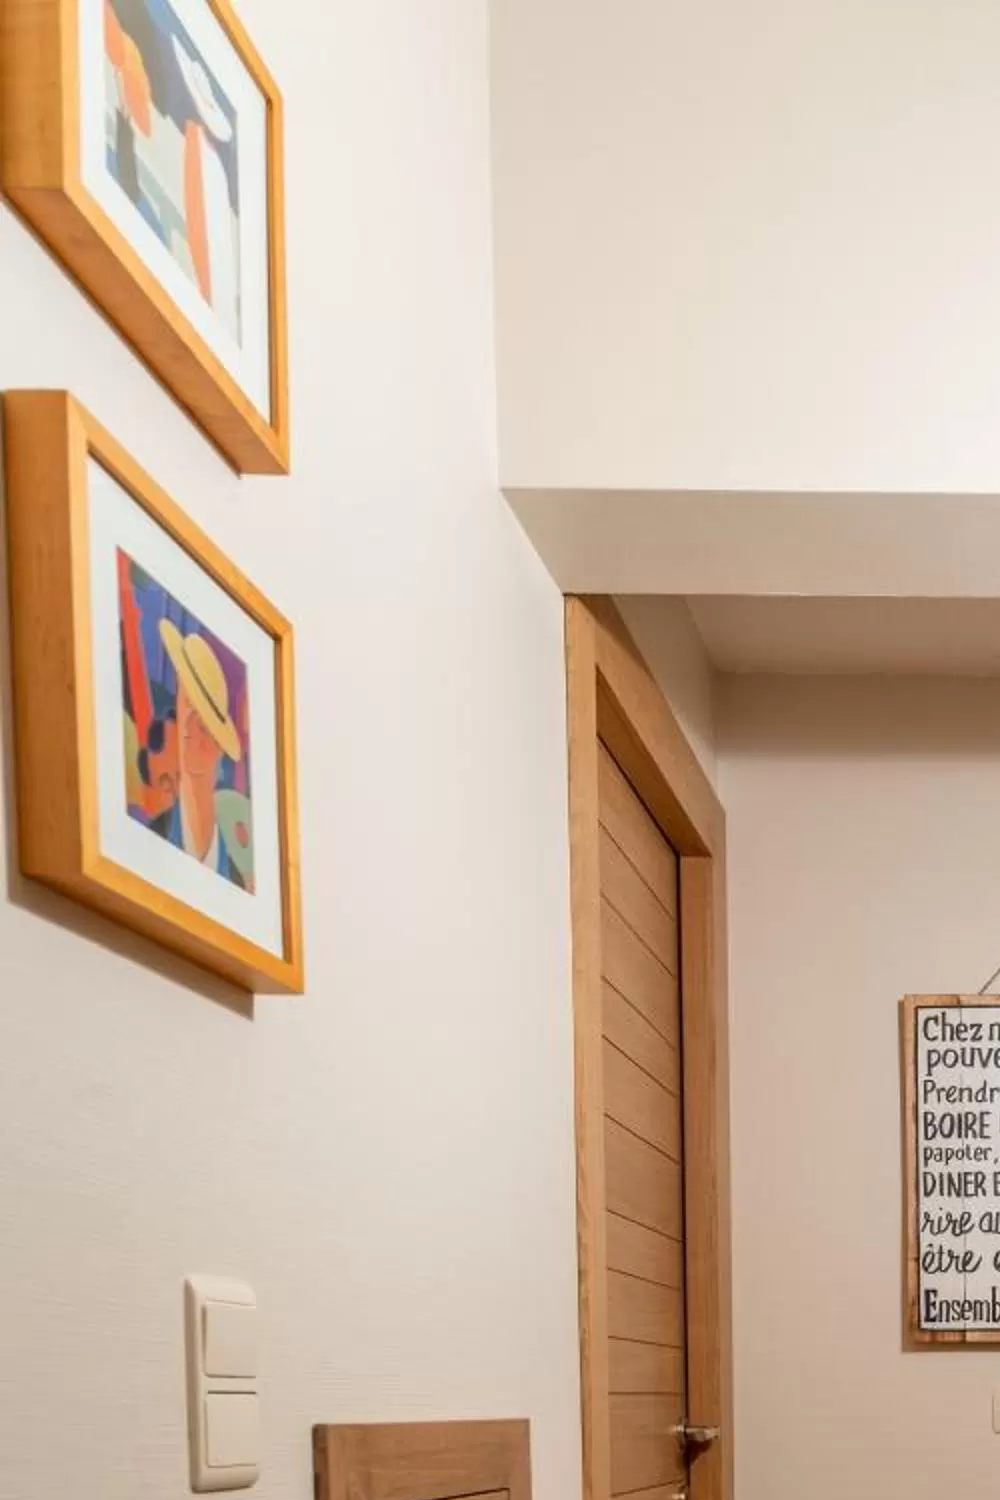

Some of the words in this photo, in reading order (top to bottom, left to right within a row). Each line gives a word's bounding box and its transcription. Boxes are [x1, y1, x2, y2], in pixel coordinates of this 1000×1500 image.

[923, 1011, 983, 1043] Chez
[923, 1111, 992, 1140] BOIRE
[923, 1144, 999, 1167] papoter,
[923, 1171, 986, 1198] DINER
[921, 1207, 974, 1236] rire
[921, 1243, 982, 1274] être
